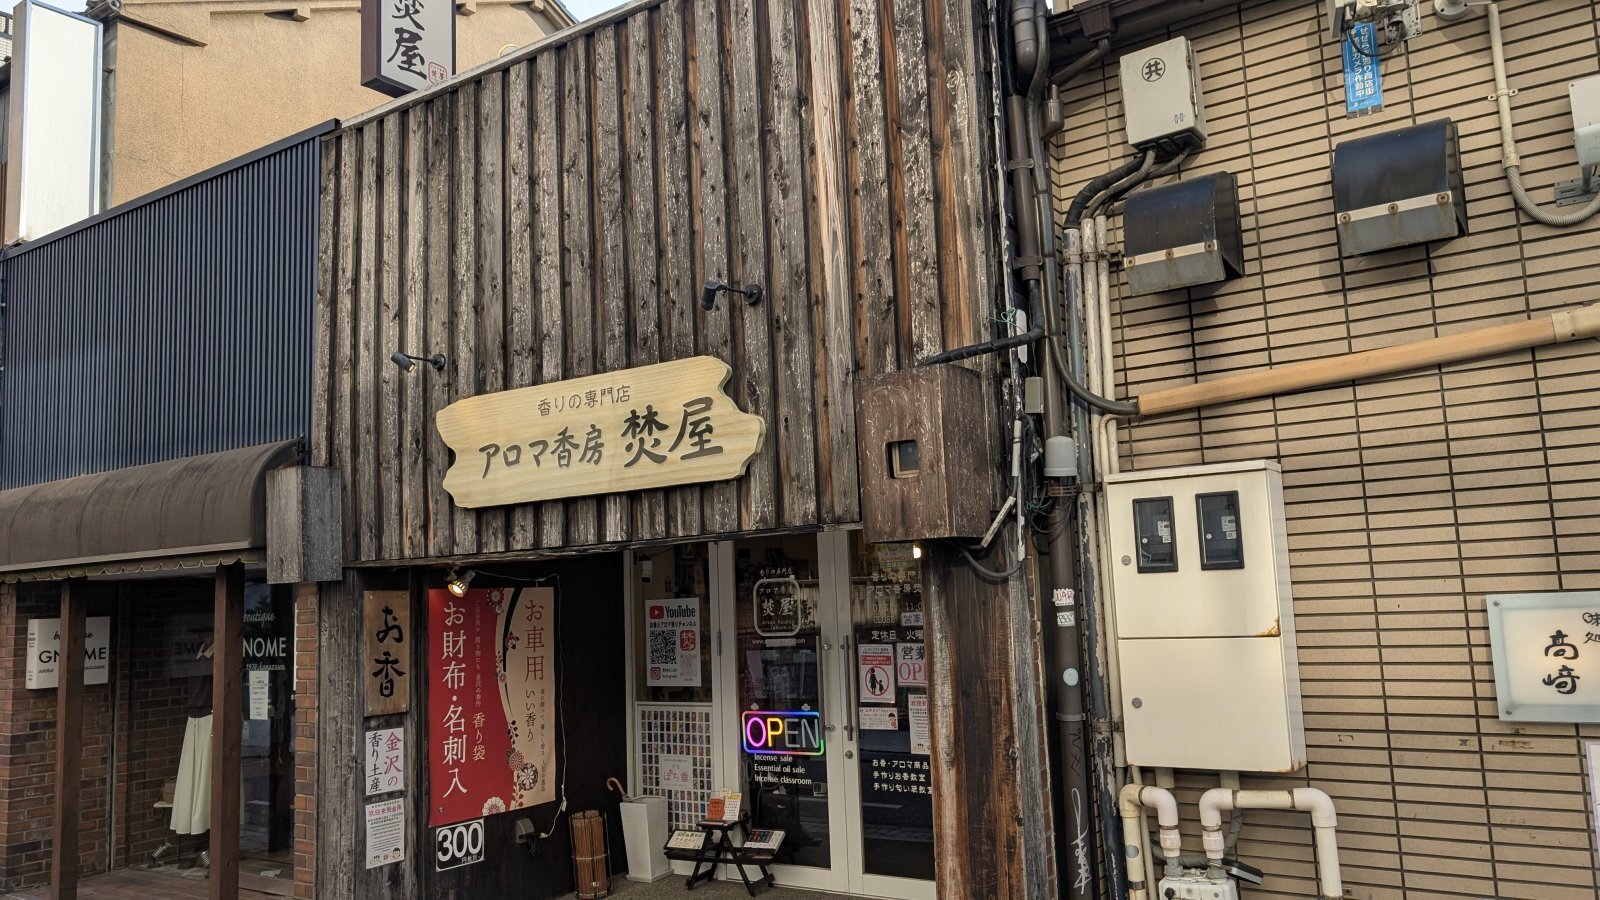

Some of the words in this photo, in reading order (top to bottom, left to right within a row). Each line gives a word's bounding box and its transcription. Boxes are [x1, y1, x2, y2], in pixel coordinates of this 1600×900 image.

[1144, 60, 1163, 81] 共
[537, 384, 631, 416] 香りの専門店
[479, 424, 605, 479] アロマ香房
[619, 396, 724, 468] 焚屋
[665, 604, 696, 618] YouTube
[761, 598, 793, 617] 焚屋
[524, 600, 545, 682] お車用
[871, 630, 896, 640] 定休日
[39, 647, 107, 664] GNME
[372, 606, 406, 697] お香
[441, 601, 468, 798] お財布・名刺入
[525, 689, 537, 742] いい香り
[472, 711, 486, 761] 香り袋
[746, 717, 820, 749] OPEN
[368, 731, 383, 793] 香り土産
[384, 731, 402, 786] 金沢の
[754, 753, 778, 762] Incense
[754, 763, 781, 772] Essential
[782, 764, 791, 773] oil
[792, 766, 806, 774] sale
[872, 758, 930, 770] お香・アロマ商品
[754, 773, 779, 783] Incense
[780, 775, 812, 785] classroom
[873, 770, 926, 782] 手作りお香教室
[438, 823, 482, 862] 300
